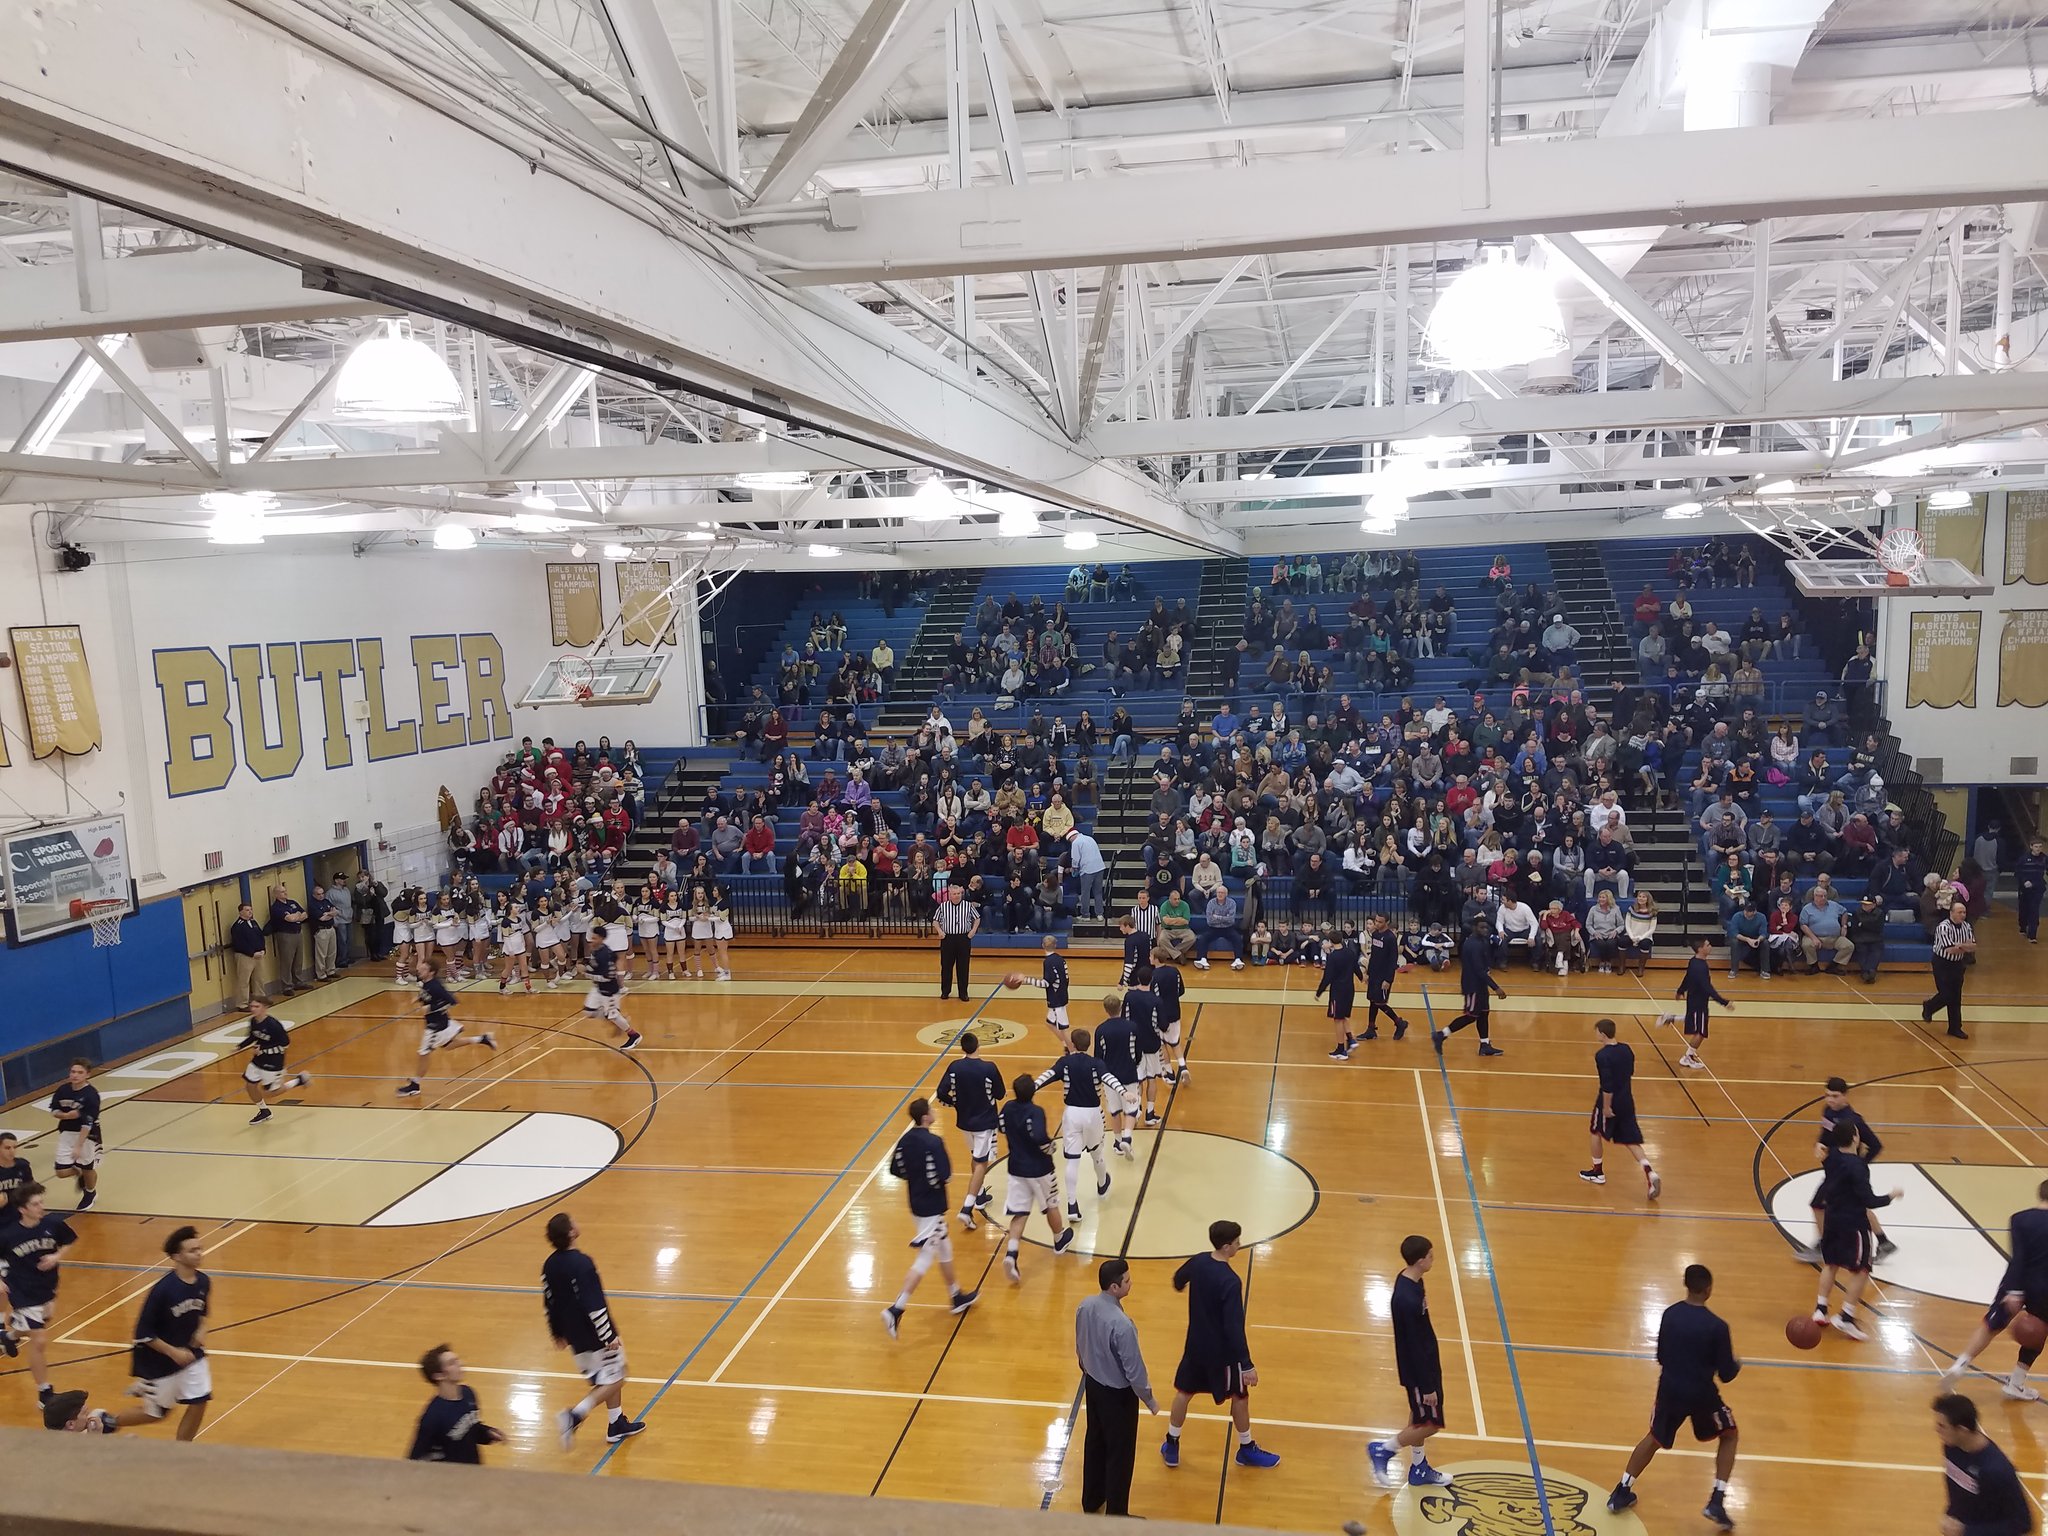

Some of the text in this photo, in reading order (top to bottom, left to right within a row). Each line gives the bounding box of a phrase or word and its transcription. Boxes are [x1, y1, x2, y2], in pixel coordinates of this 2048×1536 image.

[1925, 508, 1979, 517] CHAMPIONS
[1934, 613, 1959, 621] BOYS
[14, 630, 80, 642] GIRLS TRACK
[30, 641, 70, 652] SECTION
[1918, 638, 1973, 646] CHAMPIONS
[25, 653, 79, 664] CHAMPIONS
[60, 703, 74, 713] 2011
[152, 632, 514, 798] BUTLER
[39, 735, 58, 744] 1997
[32, 841, 72, 856] SPORTS
[38, 850, 85, 866] MEDICINE
